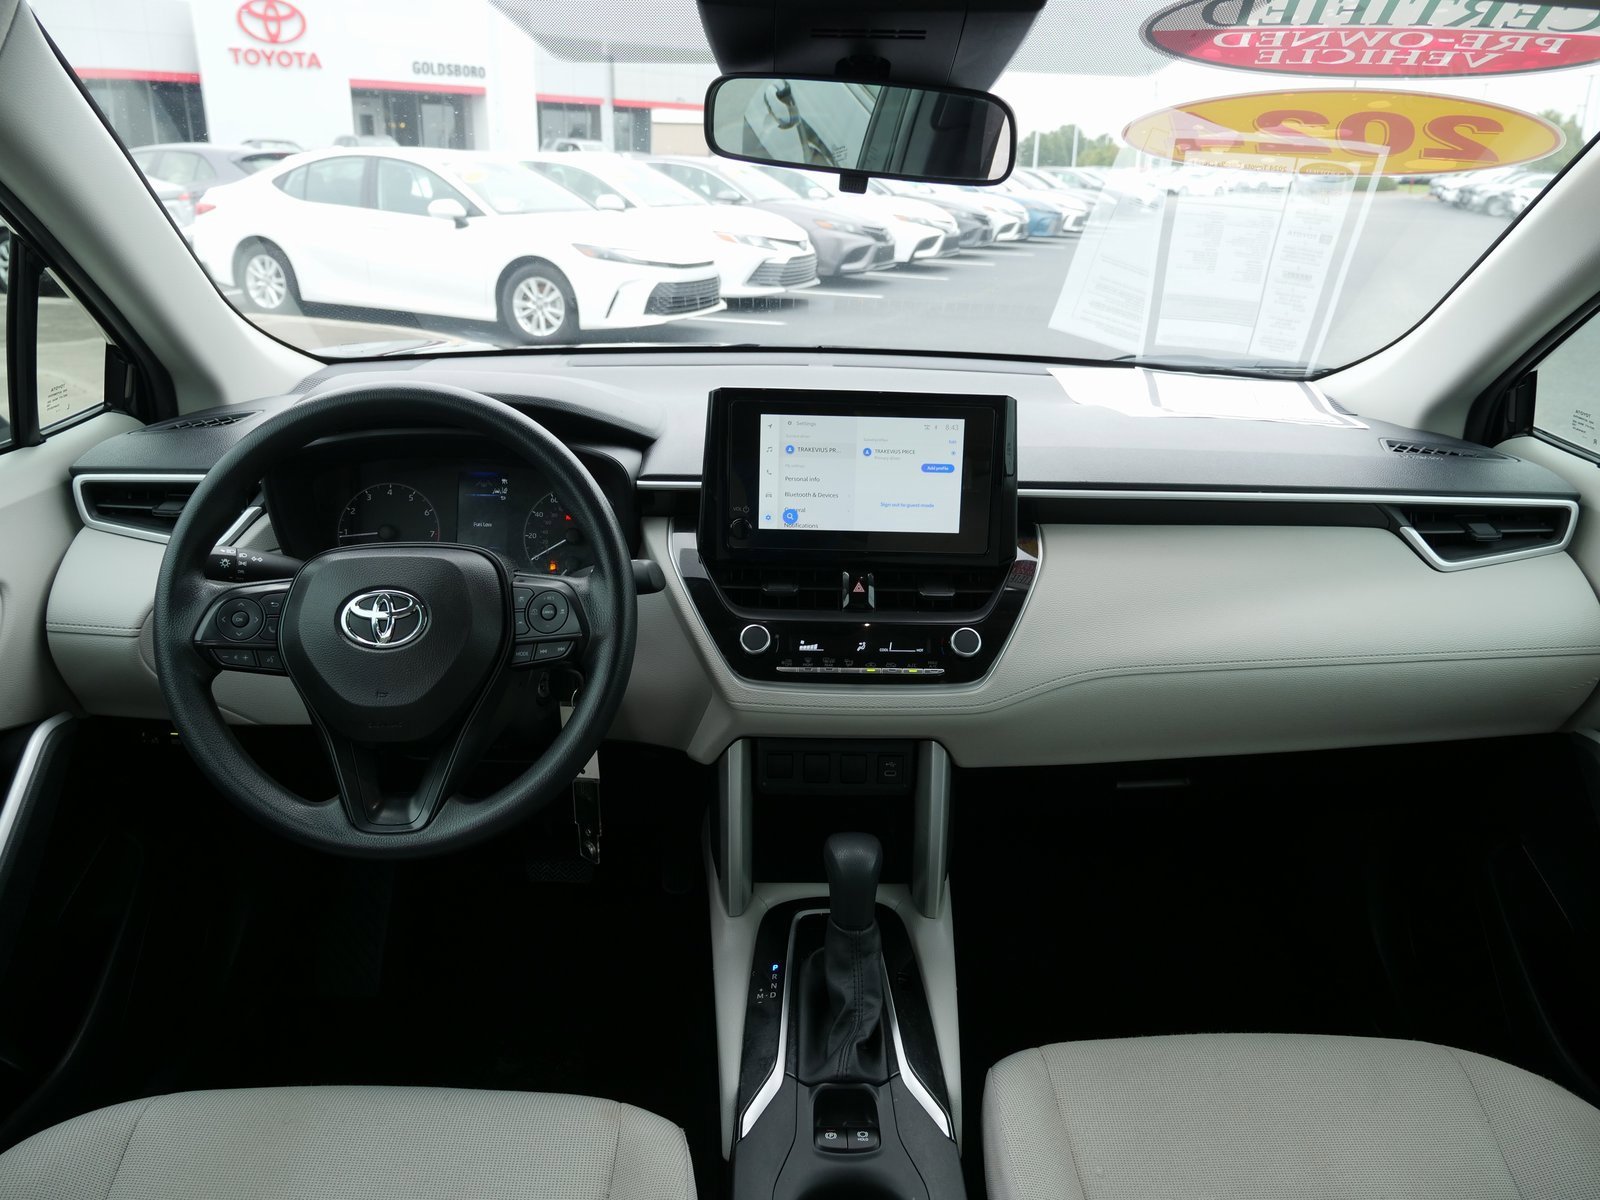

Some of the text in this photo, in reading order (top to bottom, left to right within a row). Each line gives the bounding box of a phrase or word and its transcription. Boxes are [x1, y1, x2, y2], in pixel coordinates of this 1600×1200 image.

[228, 47, 322, 69] TOYOTA
[412, 61, 486, 79] GOLDSBORO
[430, 530, 435, 538] 7
